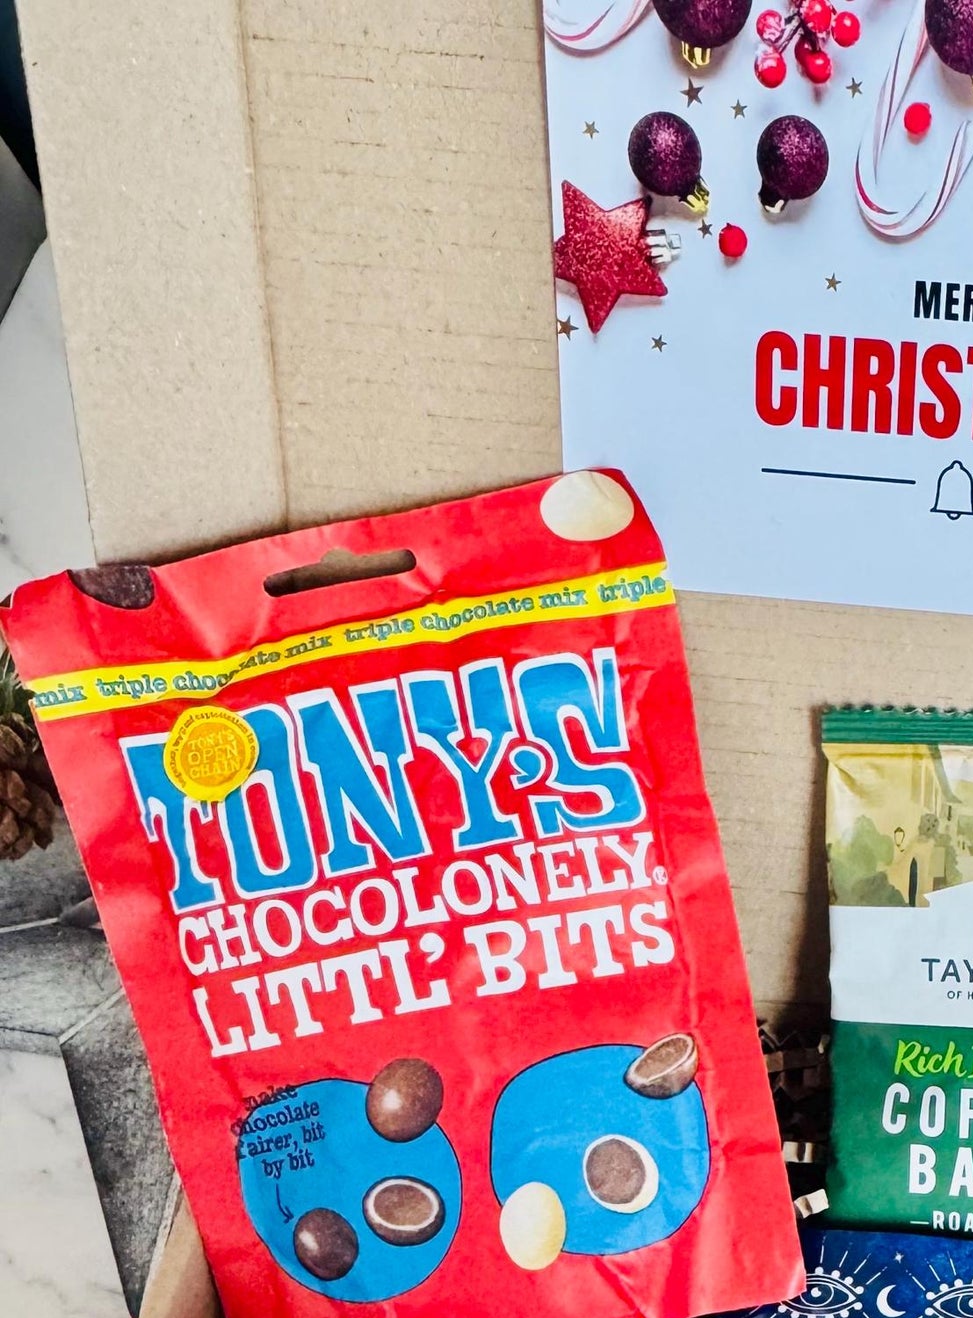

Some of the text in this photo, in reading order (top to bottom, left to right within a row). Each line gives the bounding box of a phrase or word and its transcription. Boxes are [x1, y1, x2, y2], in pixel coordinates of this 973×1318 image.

[33, 683, 87, 708] mix
[95, 673, 168, 699] triple
[284, 635, 332, 658] mix
[344, 616, 415, 643] triple
[420, 594, 534, 632] chocolate
[538, 586, 588, 610] mix
[598, 573, 667, 604] triple
[187, 740, 239, 766] OPEN
[189, 757, 241, 780] CHAIN
[119, 648, 647, 915] TONY'S
[192, 901, 676, 1058] LITTL' BITS
[946, 990, 964, 1001] OF
[893, 1039, 967, 1080] Rich
[300, 1121, 326, 1144] bit
[261, 1147, 315, 1180] by bit
